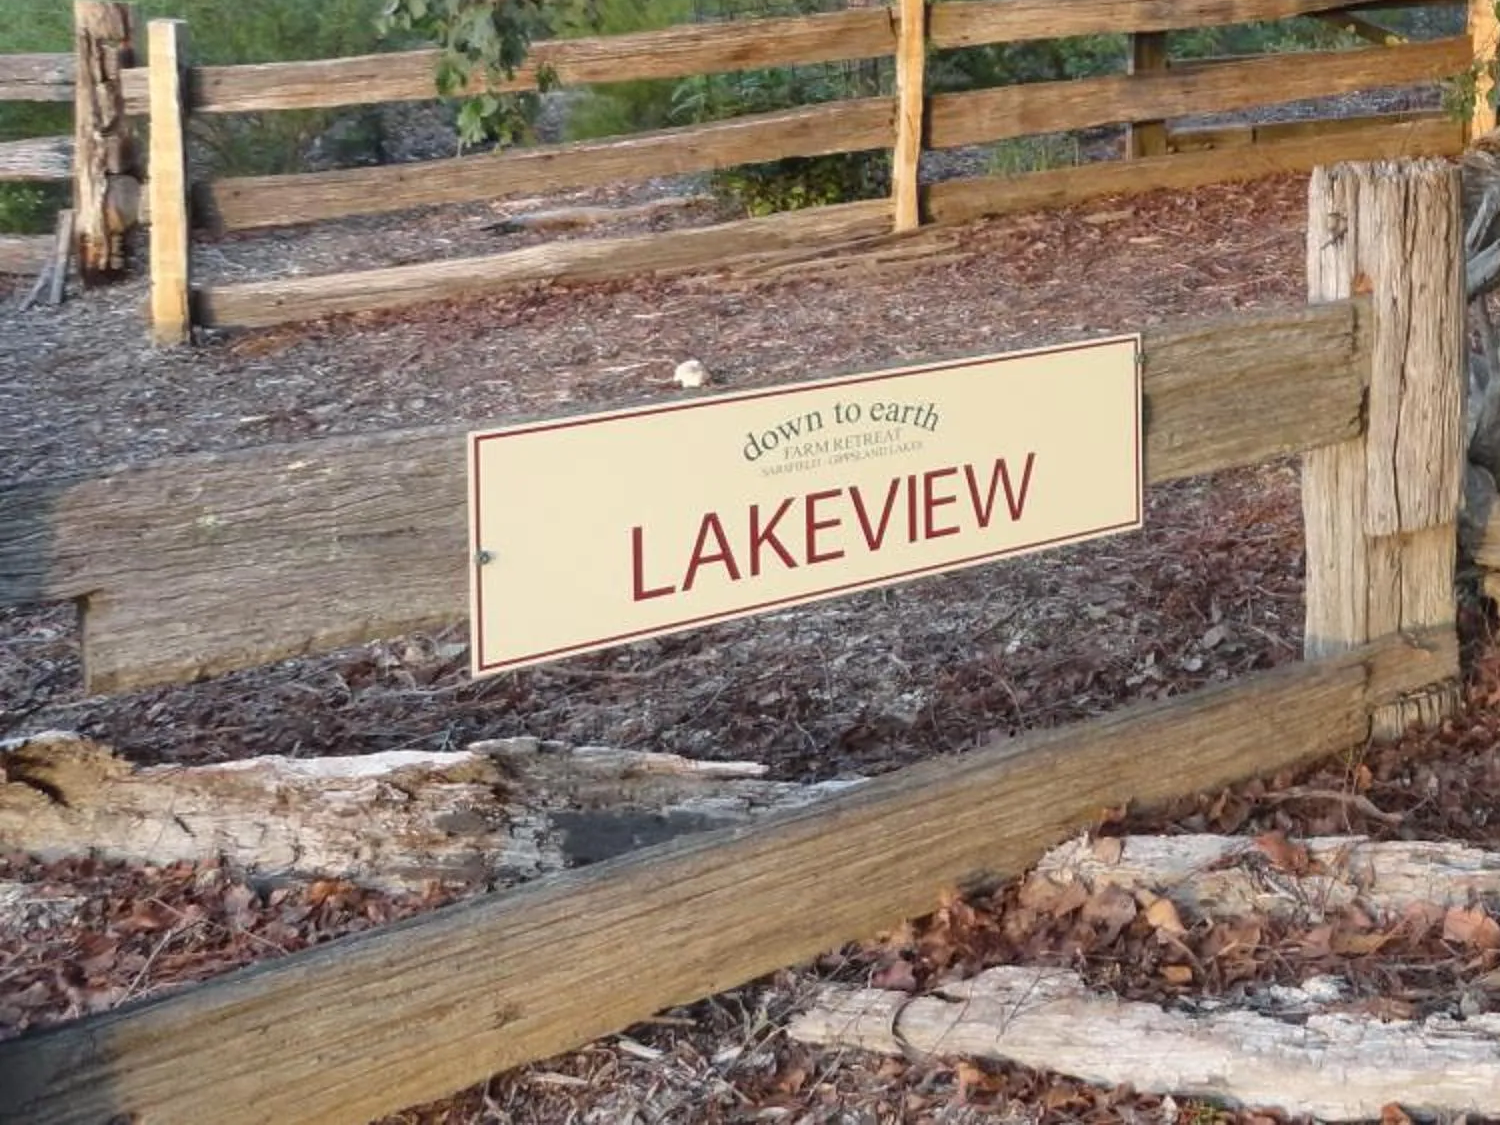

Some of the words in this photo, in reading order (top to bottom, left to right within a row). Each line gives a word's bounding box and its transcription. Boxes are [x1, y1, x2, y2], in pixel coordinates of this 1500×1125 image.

[743, 410, 823, 462] down
[833, 401, 861, 424] to
[870, 401, 940, 432] earth
[783, 439, 829, 460] FARM
[833, 429, 901, 452] RETREAT
[631, 452, 1035, 602] LAKEVIEW
